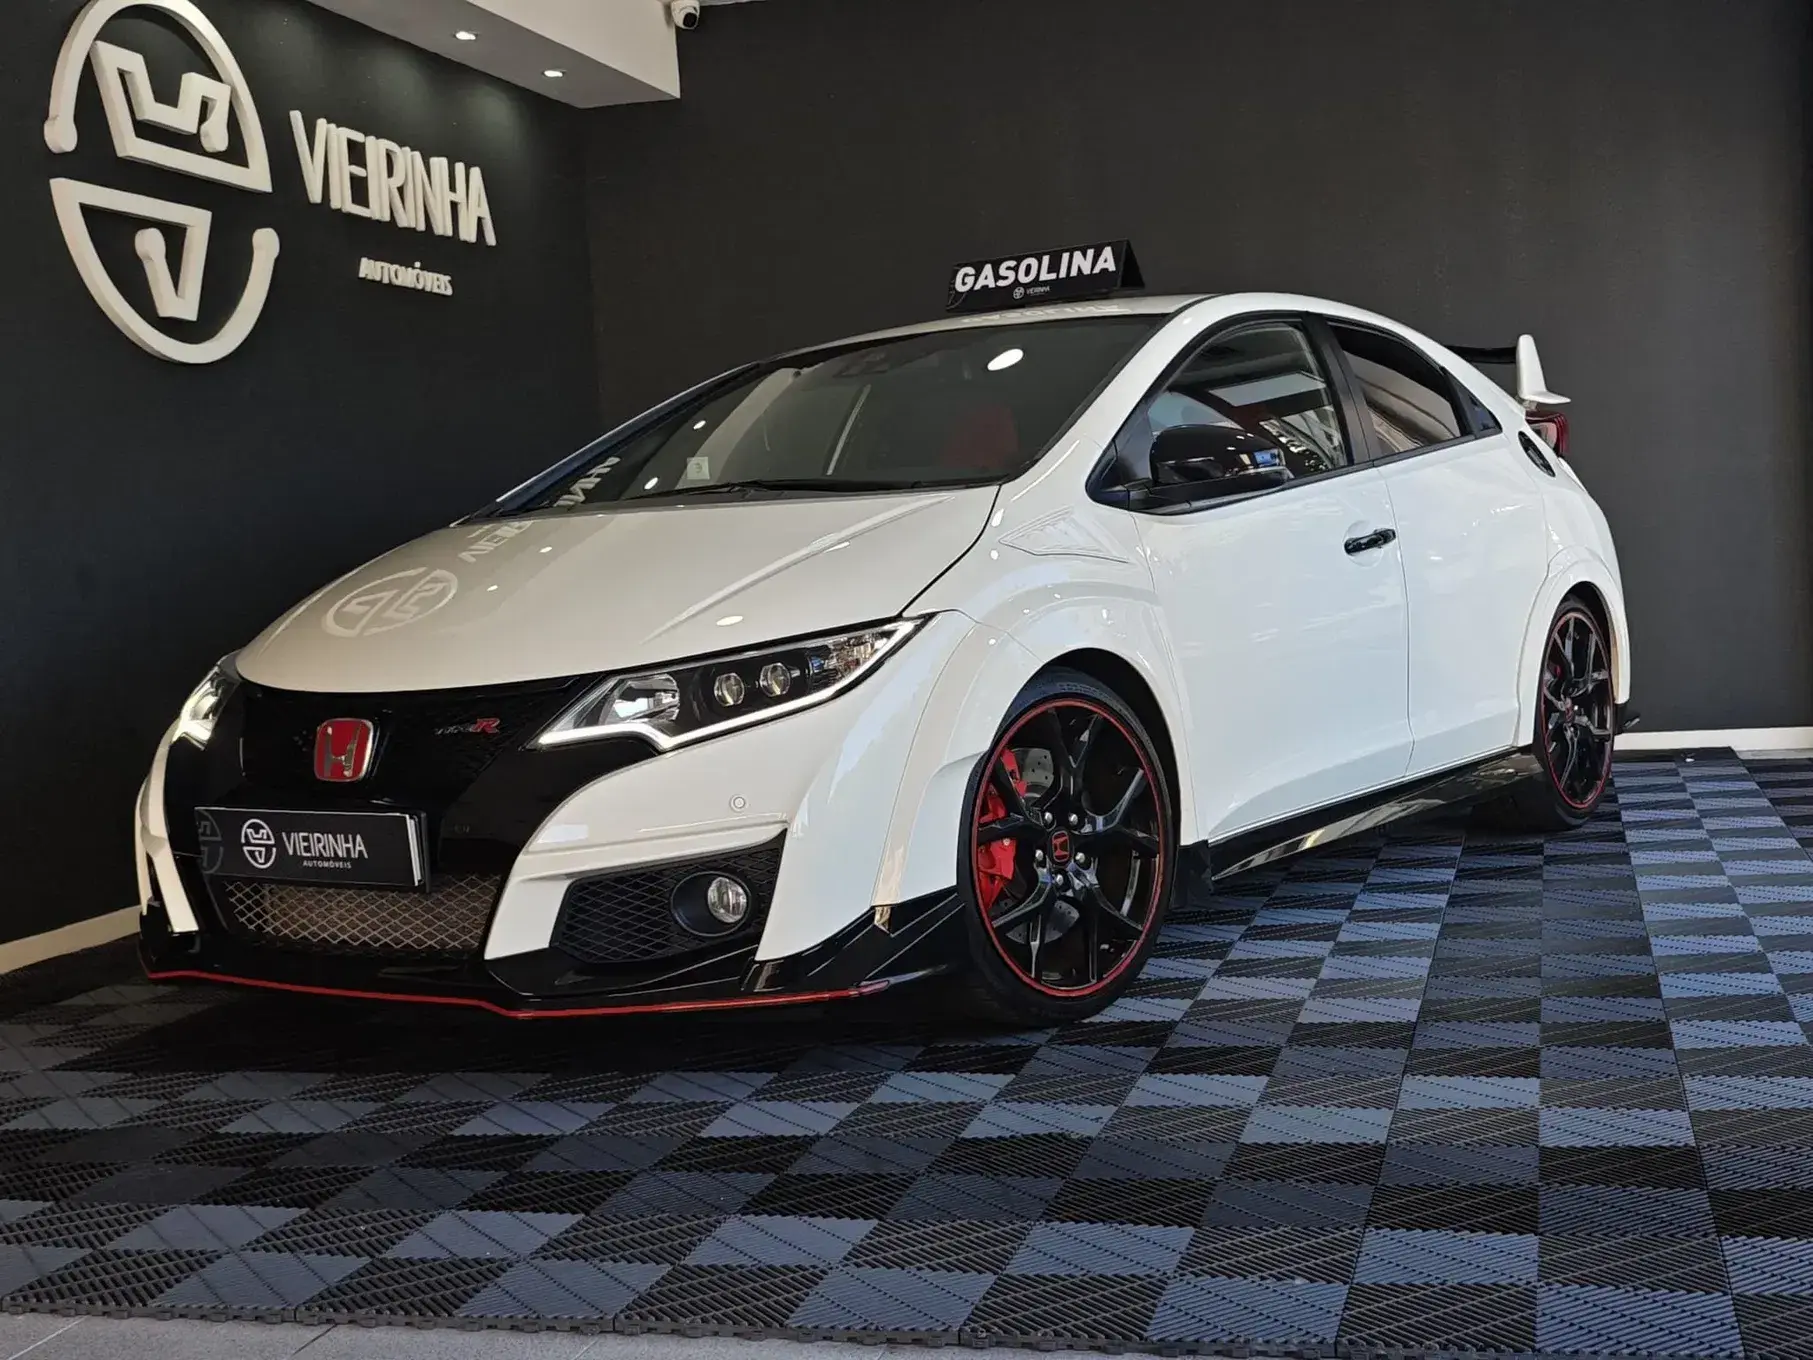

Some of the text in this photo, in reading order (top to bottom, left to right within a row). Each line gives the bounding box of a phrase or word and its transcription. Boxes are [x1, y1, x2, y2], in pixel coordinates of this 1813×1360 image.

[289, 110, 496, 246] VIEIRINHA
[358, 257, 453, 295] AUTOMÓVEIS
[954, 246, 1117, 293] GASOLINA
[281, 831, 369, 859] VIEIRINHA
